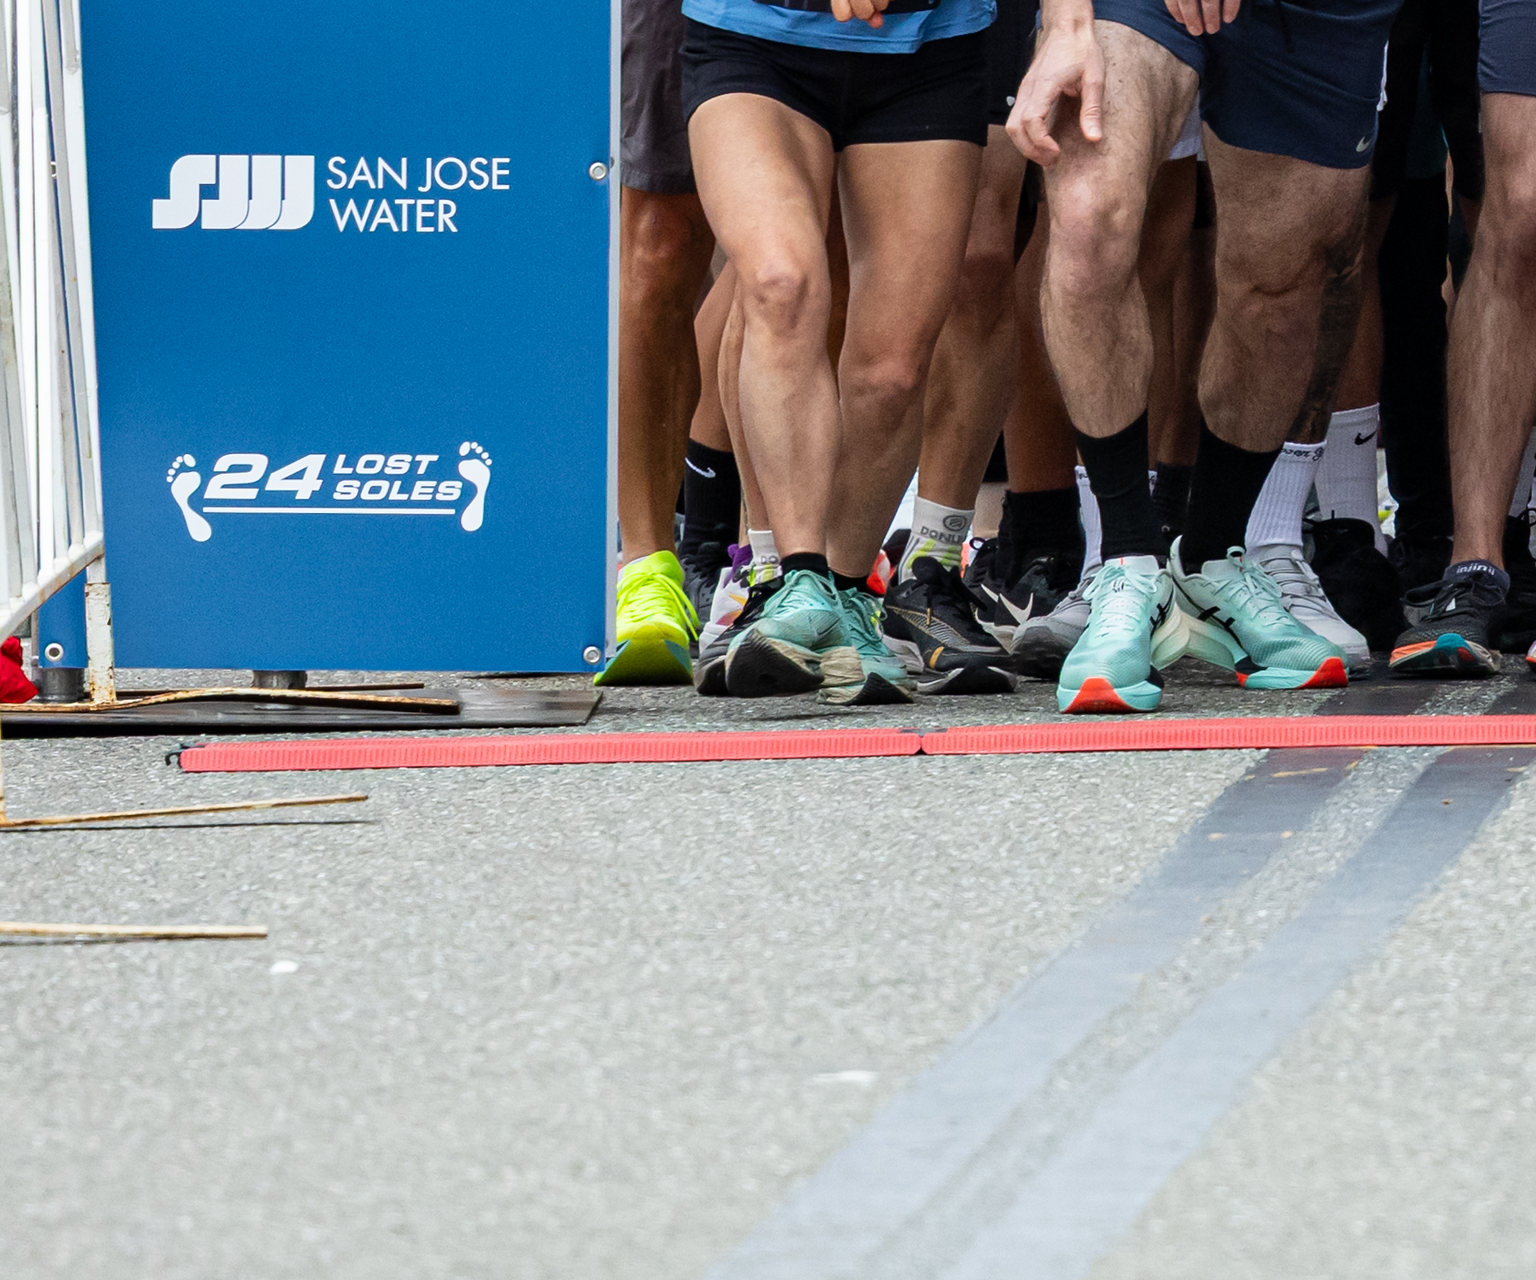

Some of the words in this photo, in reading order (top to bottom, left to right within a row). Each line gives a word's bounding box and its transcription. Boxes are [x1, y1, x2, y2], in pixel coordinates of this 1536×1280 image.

[328, 158, 407, 190] SAN
[419, 159, 510, 193] JOSE
[331, 200, 458, 233] WATER
[205, 455, 326, 500] 24
[335, 456, 439, 475] LOST
[334, 481, 463, 501] SOLES
